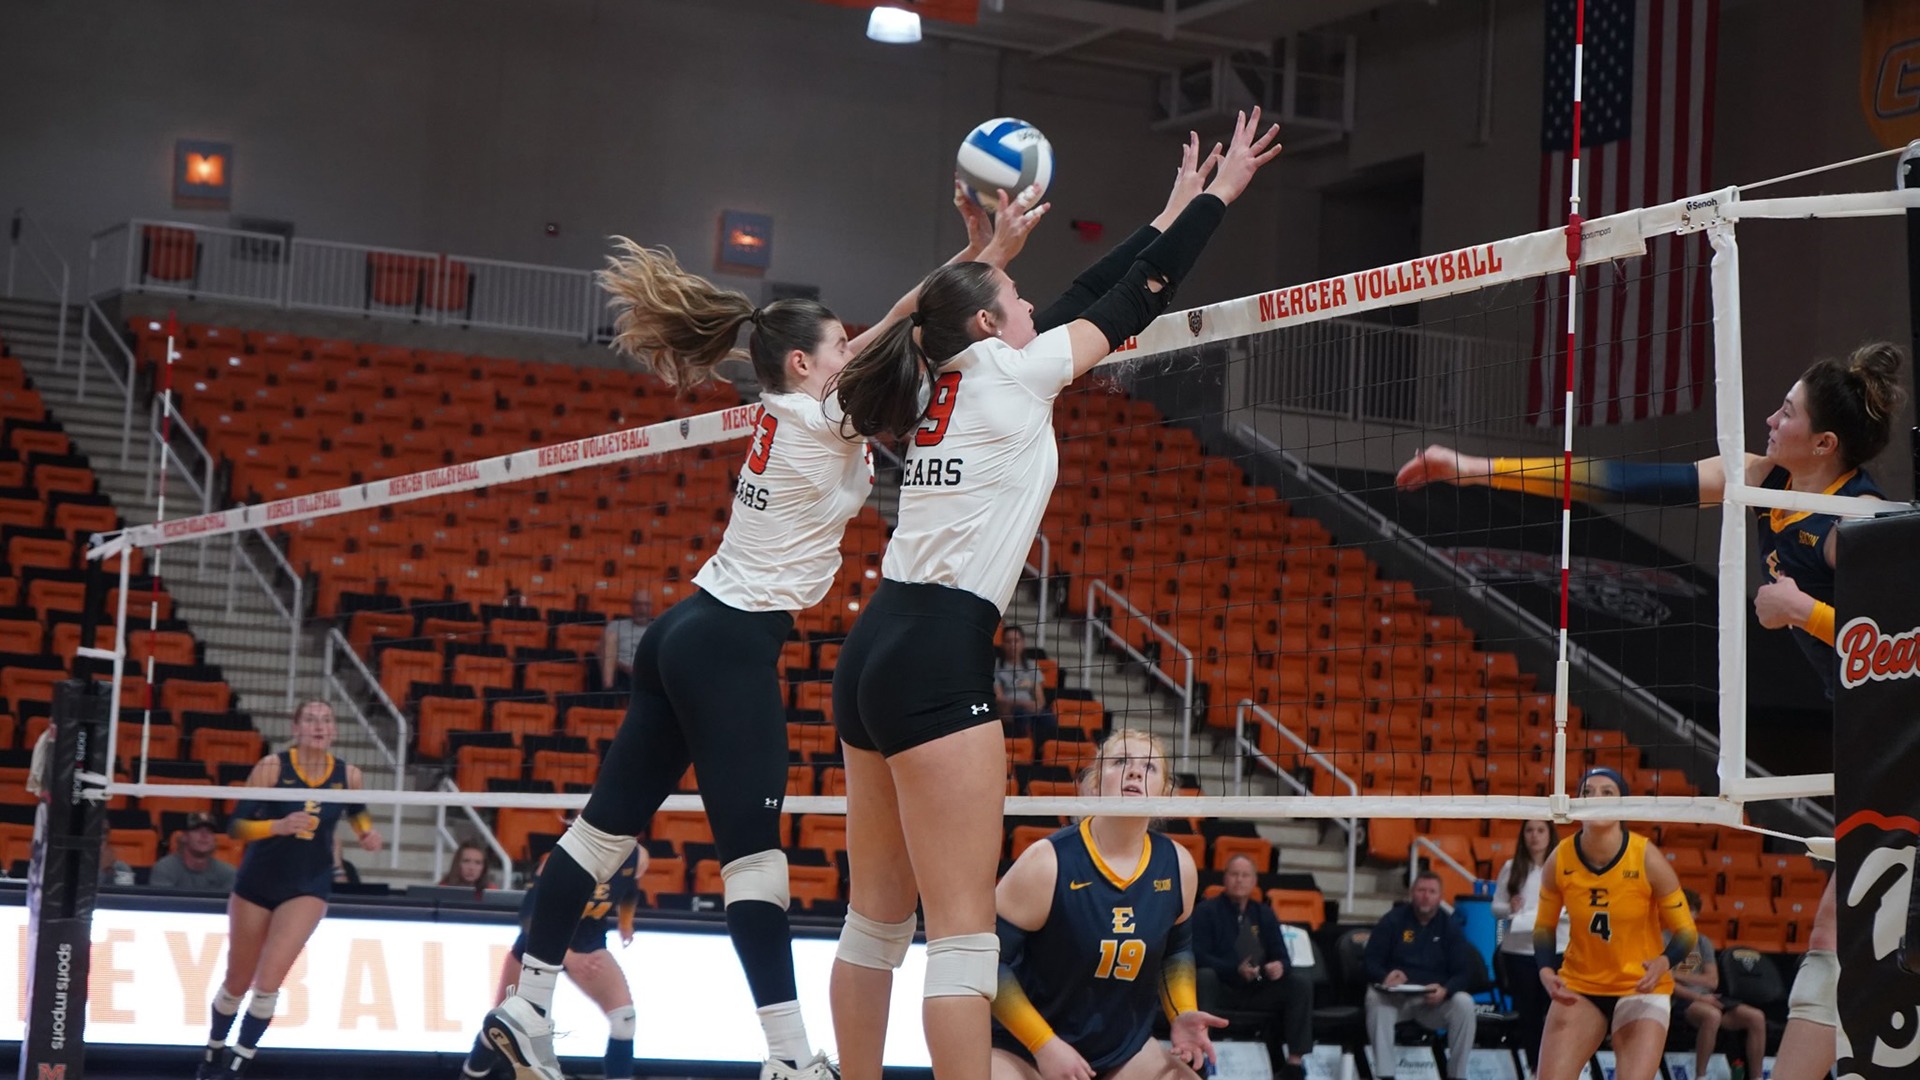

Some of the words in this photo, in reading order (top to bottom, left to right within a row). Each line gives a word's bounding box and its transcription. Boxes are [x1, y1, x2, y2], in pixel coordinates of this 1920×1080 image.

[1692, 198, 1718, 210] Senoh
[1258, 277, 1348, 323] MERCER
[1353, 243, 1503, 302] VOLLEYBALL
[721, 404, 758, 432] MERC
[914, 370, 962, 447] 9
[537, 442, 580, 468] MERCER
[581, 428, 650, 460] VOLLEYBALL
[388, 474, 423, 496] MERCER
[425, 462, 480, 490] VOLLEYBALL
[903, 458, 963, 486] EARS
[1590, 888, 1610, 908] E
[1111, 906, 1136, 934] E
[1588, 911, 1613, 944] 4
[56, 943, 72, 991] sports
[1094, 939, 1147, 982] 19
[50, 992, 68, 1050] imports
